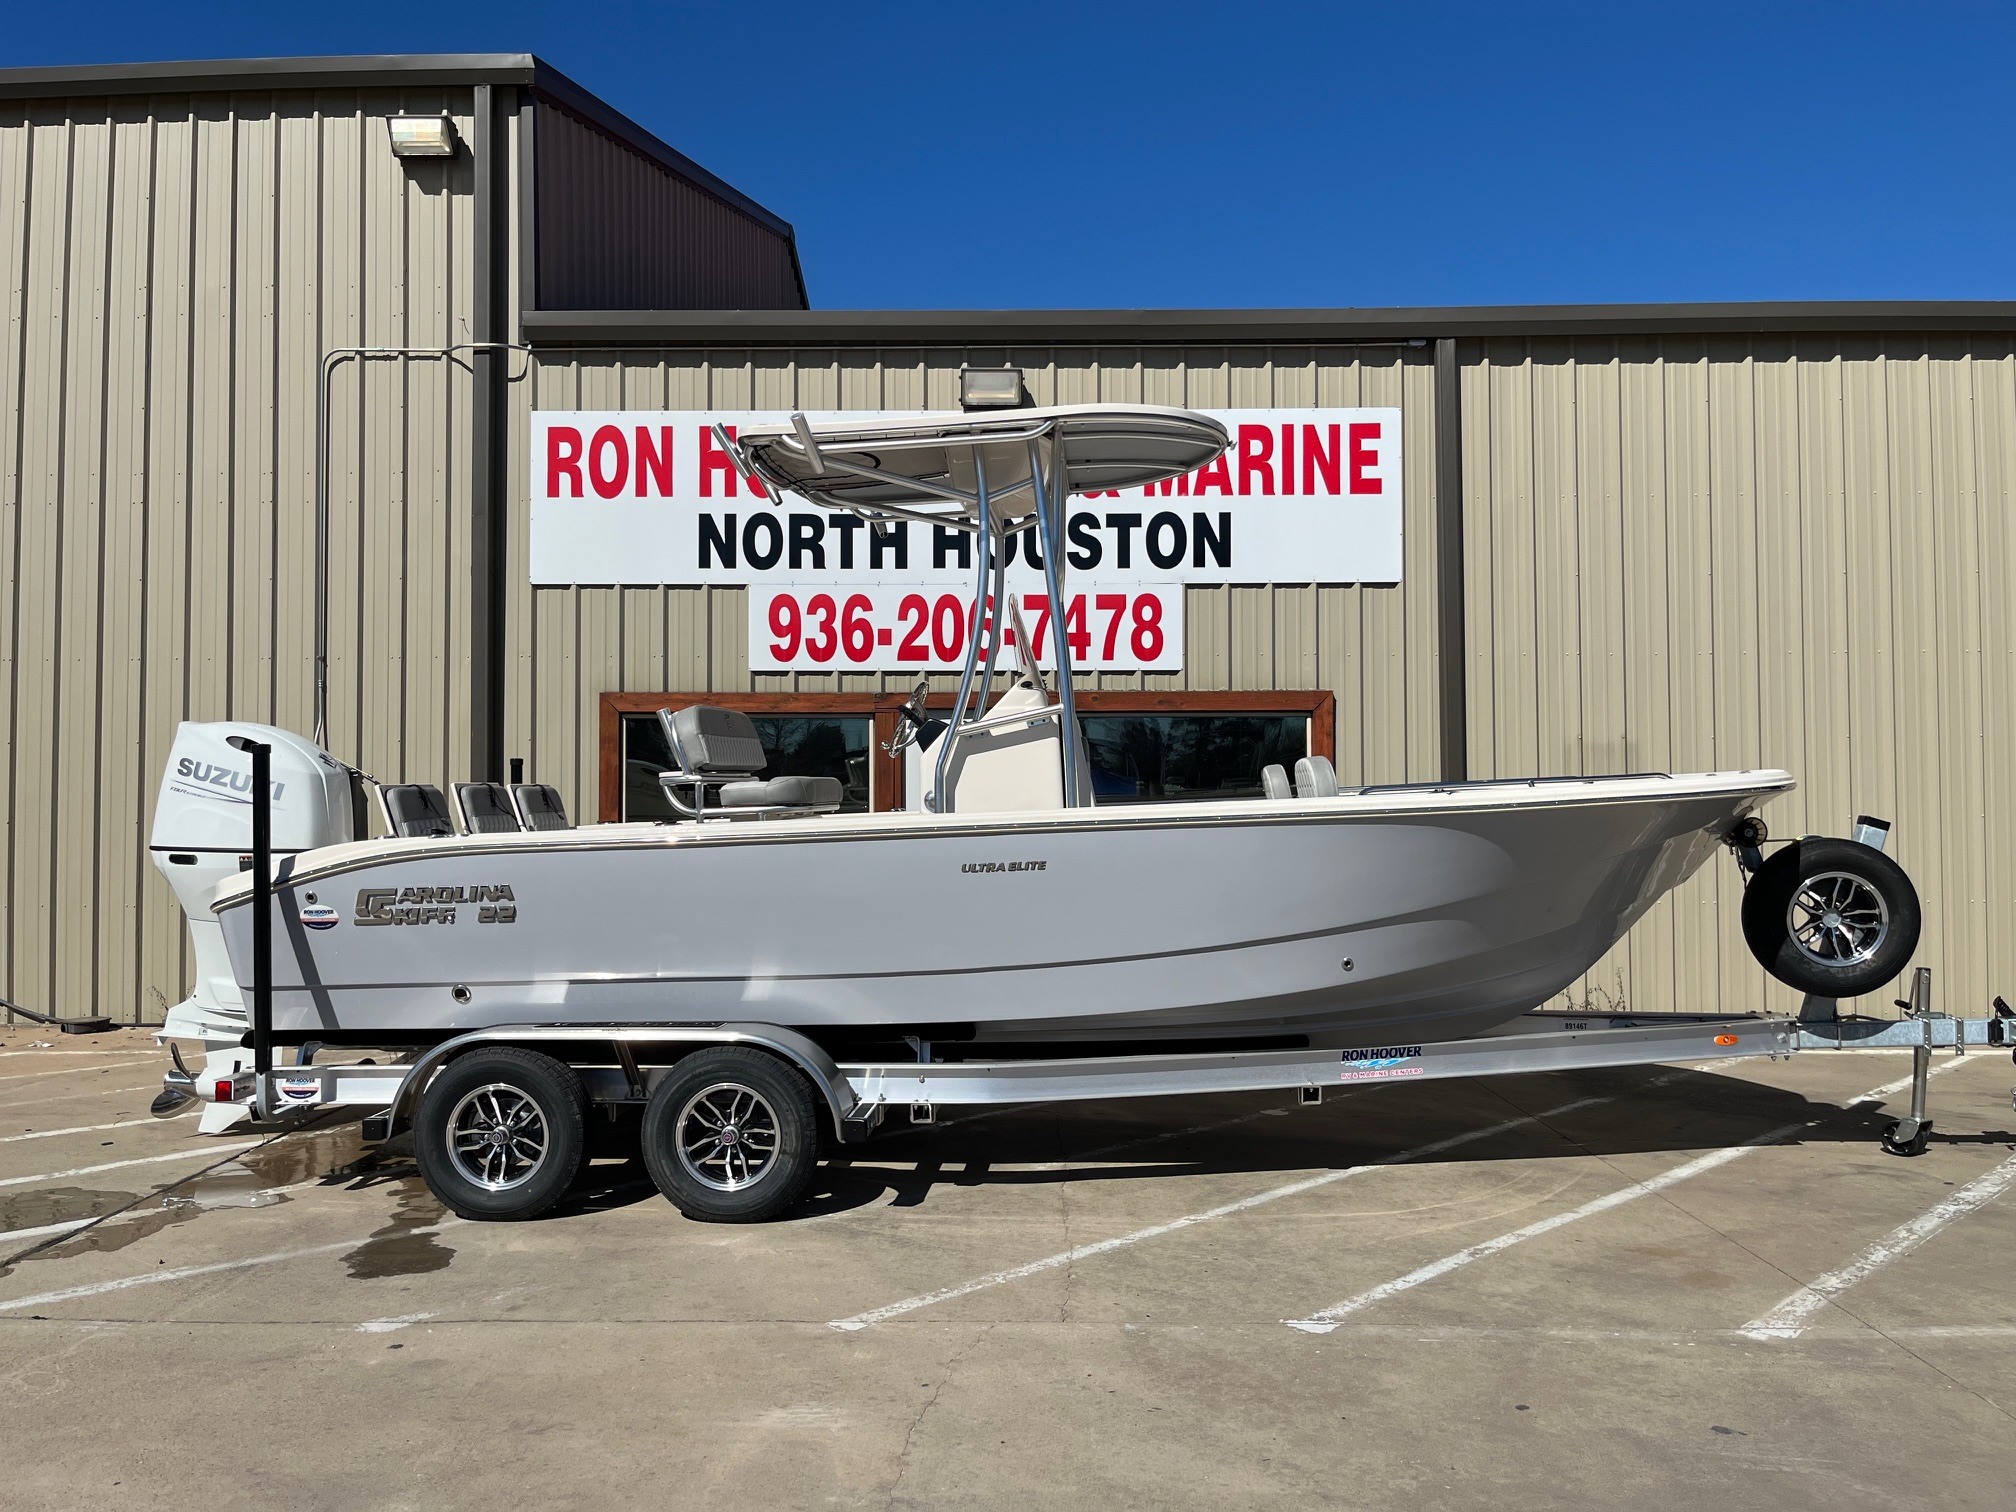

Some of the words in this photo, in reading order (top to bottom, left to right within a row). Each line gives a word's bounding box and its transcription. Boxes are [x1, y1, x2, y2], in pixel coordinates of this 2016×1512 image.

[547, 425, 674, 499] RON
[698, 511, 908, 571] NORTH
[177, 757, 286, 802] SUZUI
[961, 862, 1006, 874] ULTRA
[1007, 860, 1047, 872] ELITE
[478, 904, 518, 924] 22
[1341, 1049, 1369, 1062] RON
[1369, 1045, 1422, 1060] HOOVER
[1359, 1069, 1389, 1079] MARINE
[1389, 1067, 1424, 1077] CENTERS
